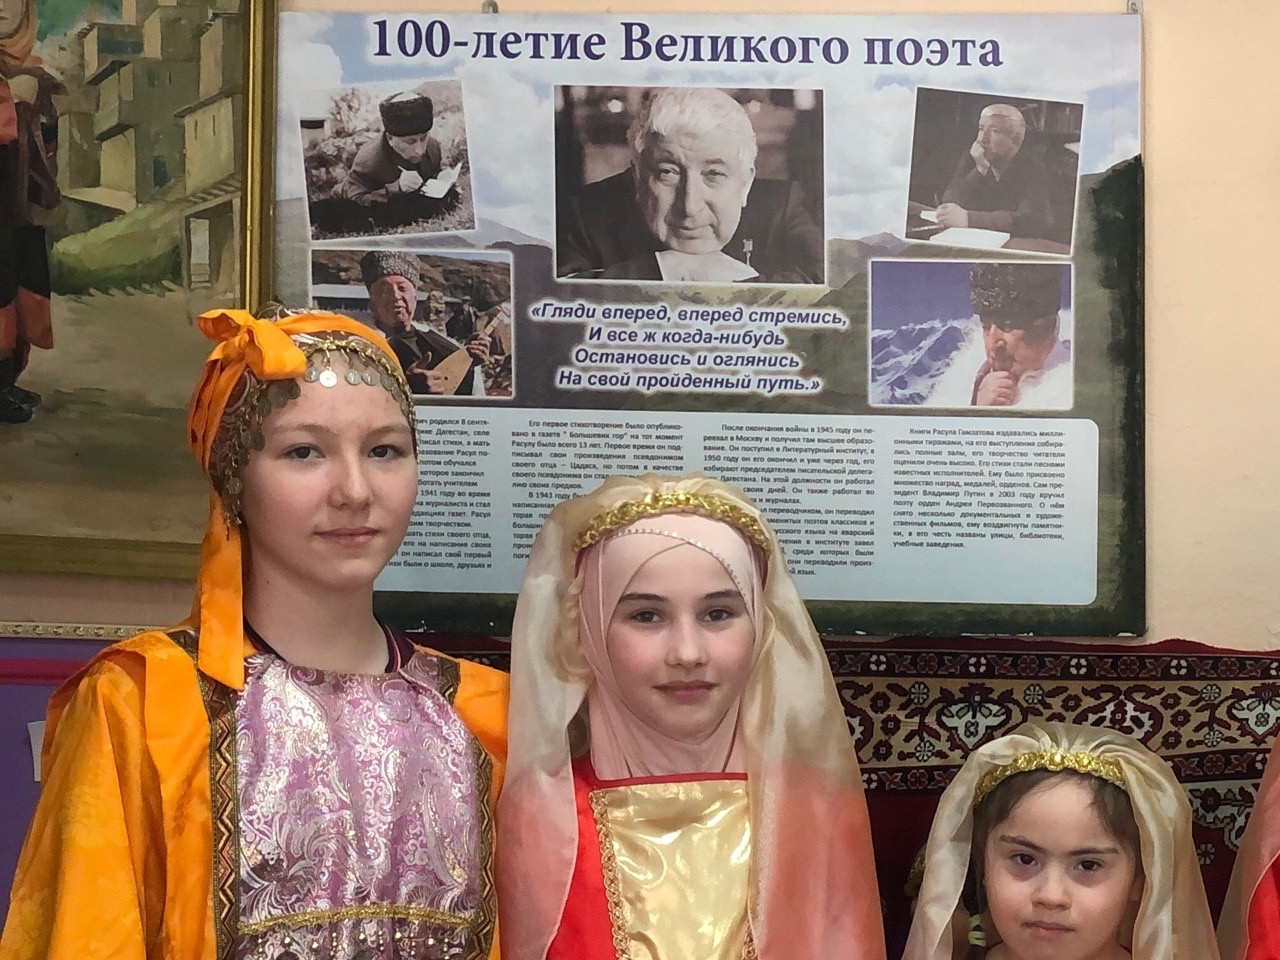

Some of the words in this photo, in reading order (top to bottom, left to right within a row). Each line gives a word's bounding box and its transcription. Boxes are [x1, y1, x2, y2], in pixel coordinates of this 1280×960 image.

[371, 19, 606, 61] 100-летие
[620, 20, 850, 65] Великого
[863, 35, 1003, 67] поэта
[531, 303, 596, 319] «Гляди
[601, 307, 672, 323] вперед,
[678, 307, 743, 324] вперед
[749, 311, 847, 326] стремись,
[588, 327, 601, 341] И
[607, 331, 638, 342] все
[642, 332, 657, 342] ж
[662, 330, 785, 348] когда-нибудь
[575, 349, 691, 366] Остановись
[697, 355, 708, 366] и
[713, 356, 800, 368] оглянись
[559, 371, 582, 385] На
[587, 372, 630, 386] свой
[636, 373, 751, 390] пройденный
[756, 379, 820, 393] путь.»
